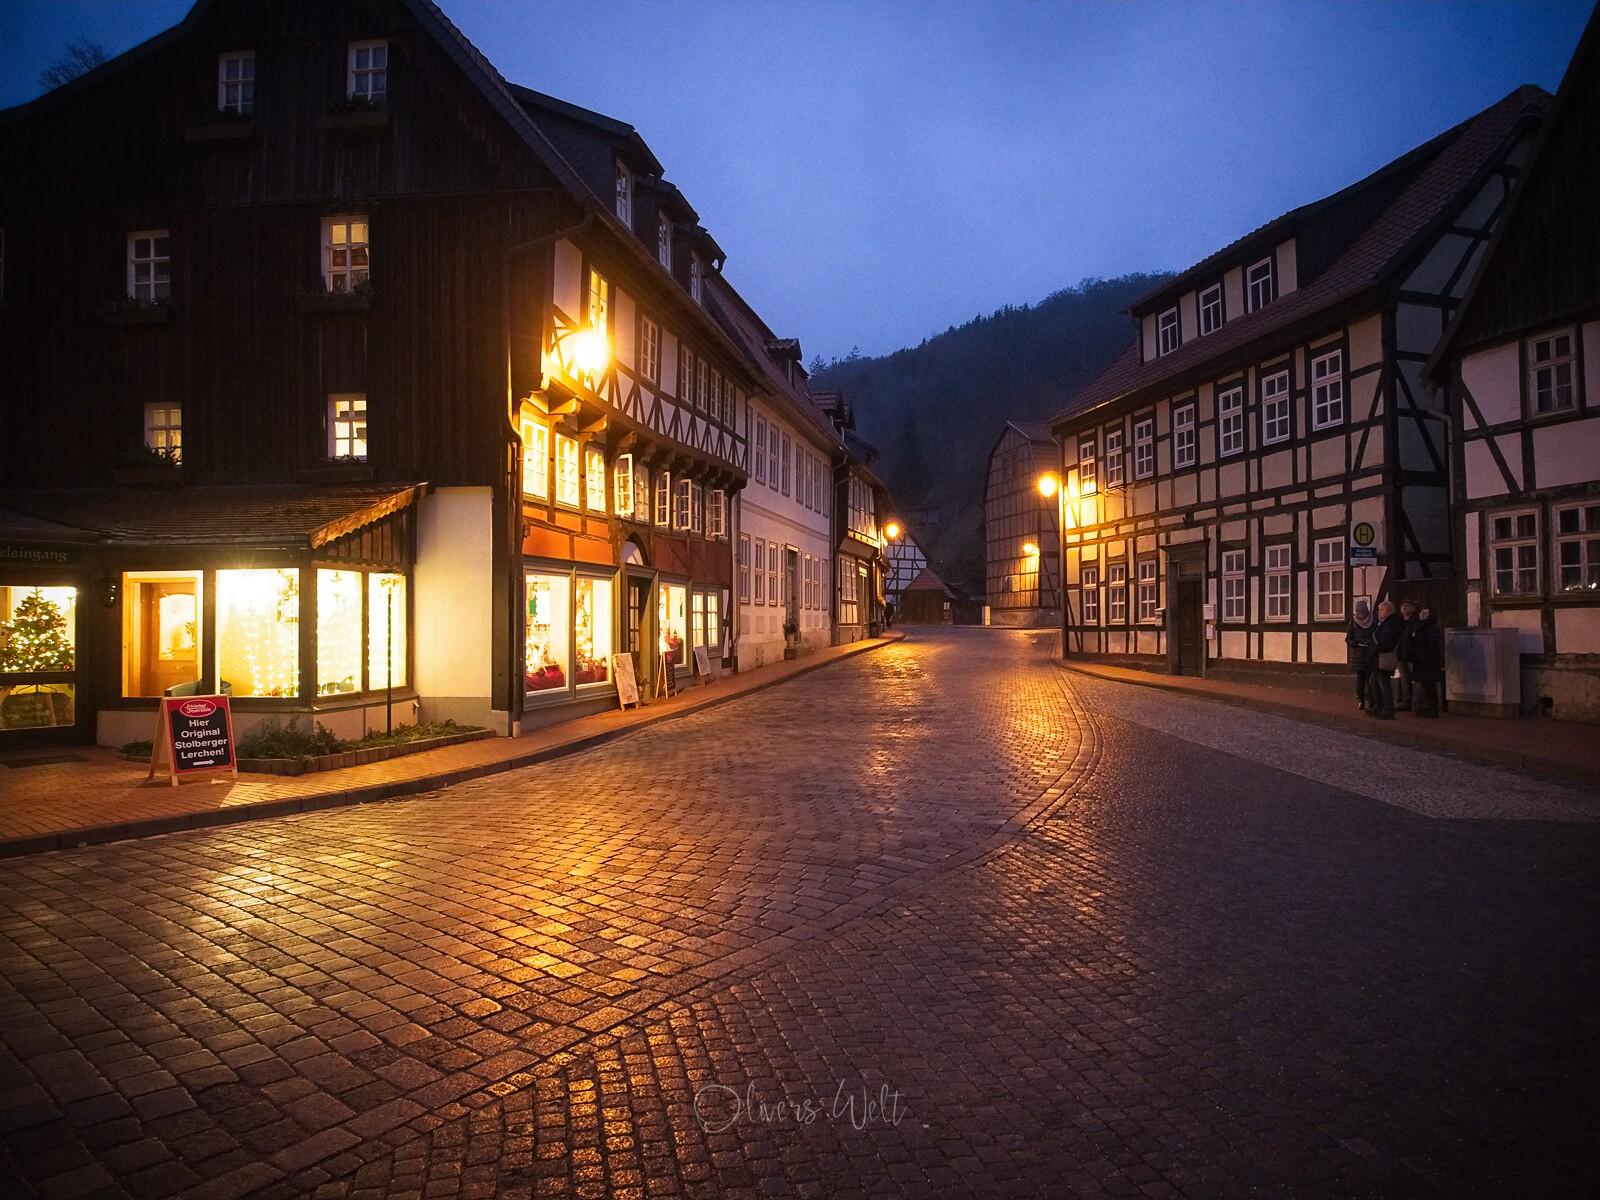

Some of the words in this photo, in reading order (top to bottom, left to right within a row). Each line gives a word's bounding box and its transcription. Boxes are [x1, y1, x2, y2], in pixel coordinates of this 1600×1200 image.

[1360, 528, 1368, 541] H
[189, 719, 209, 727] Hier
[181, 728, 220, 738] Original
[175, 738, 227, 749] Stolberger
[181, 748, 224, 759] Lerchen!
